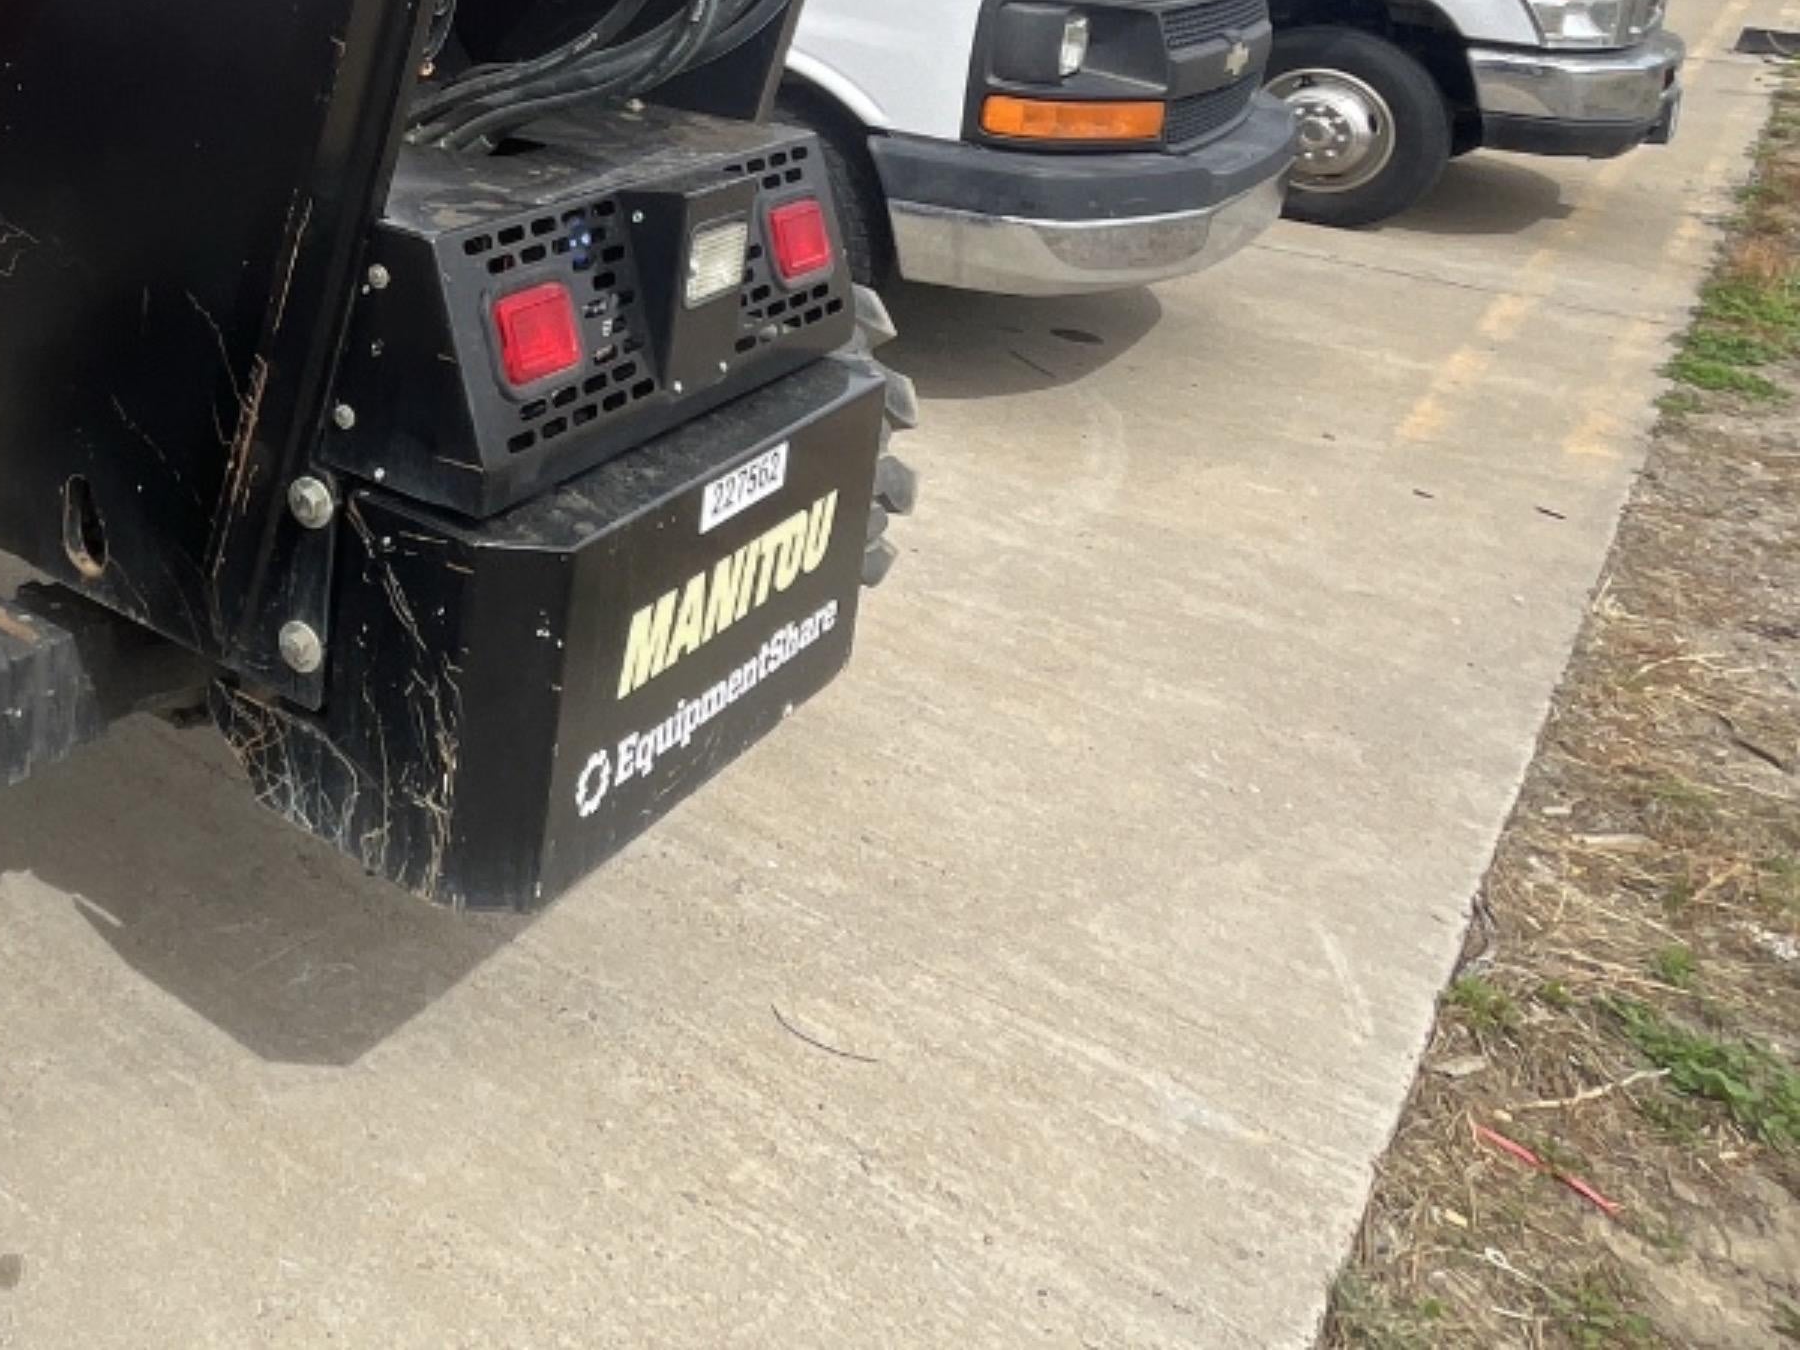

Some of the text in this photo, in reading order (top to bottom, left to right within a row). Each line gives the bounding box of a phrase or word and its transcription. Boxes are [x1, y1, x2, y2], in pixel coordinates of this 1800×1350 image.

[711, 450, 780, 515] 227562
[617, 488, 839, 700] MANITOU
[614, 599, 839, 787] EquipmentShare
